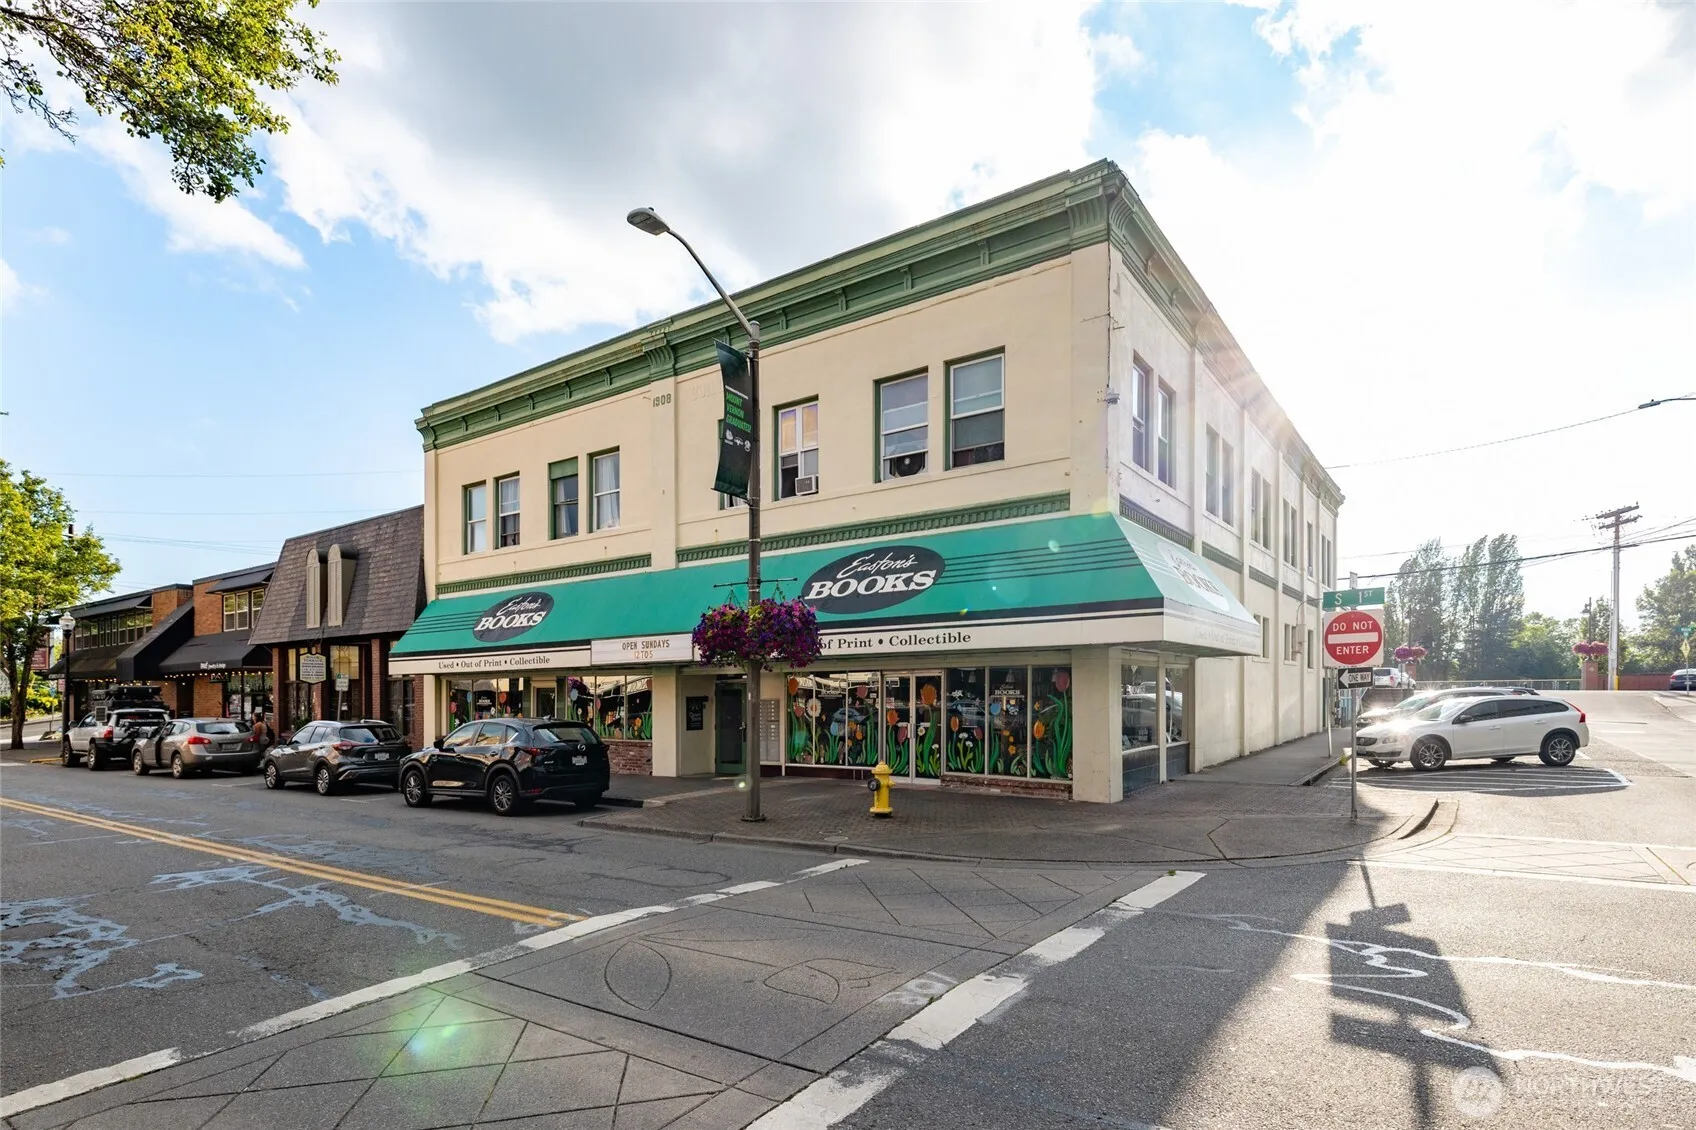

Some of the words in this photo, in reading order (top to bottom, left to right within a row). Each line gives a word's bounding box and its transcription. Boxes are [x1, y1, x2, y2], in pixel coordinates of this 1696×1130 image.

[652, 393, 671, 407] 1908
[836, 552, 918, 579] Easton's
[804, 569, 937, 600] BOOKS
[1334, 592, 1342, 605] S
[474, 610, 547, 631] BOOKS
[1332, 622, 1347, 631] DO
[1352, 621, 1374, 630] NOT
[621, 641, 638, 650] OPEN
[641, 639, 670, 649] SUNDAYS
[838, 637, 873, 649] Print
[889, 631, 972, 646] Collectible
[1336, 645, 1369, 655] ENTER
[438, 661, 455, 670] Used
[460, 660, 473, 668] Out
[474, 659, 482, 668] of
[483, 658, 502, 667] Print
[509, 655, 551, 666] Collectible
[1348, 673, 1359, 682] ONE
[1359, 672, 1370, 681] WAY
